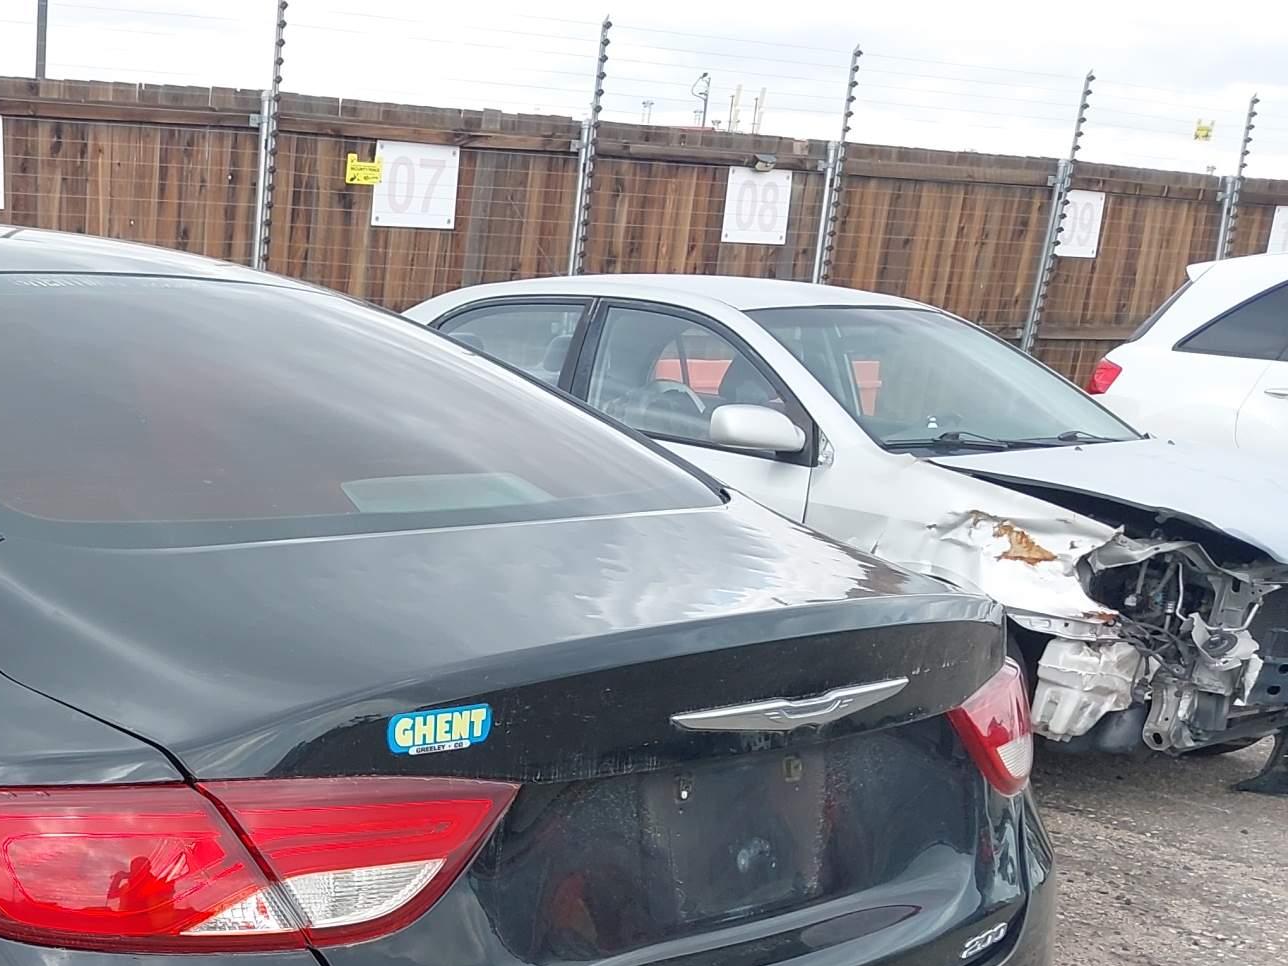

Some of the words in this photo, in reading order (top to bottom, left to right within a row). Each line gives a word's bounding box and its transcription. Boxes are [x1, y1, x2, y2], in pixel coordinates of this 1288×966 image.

[388, 156, 447, 214] 07
[735, 179, 780, 232] 08
[394, 708, 487, 747] GHENT
[415, 744, 446, 754] GREELEY
[454, 741, 464, 749] CO
[961, 922, 1008, 958] 200
